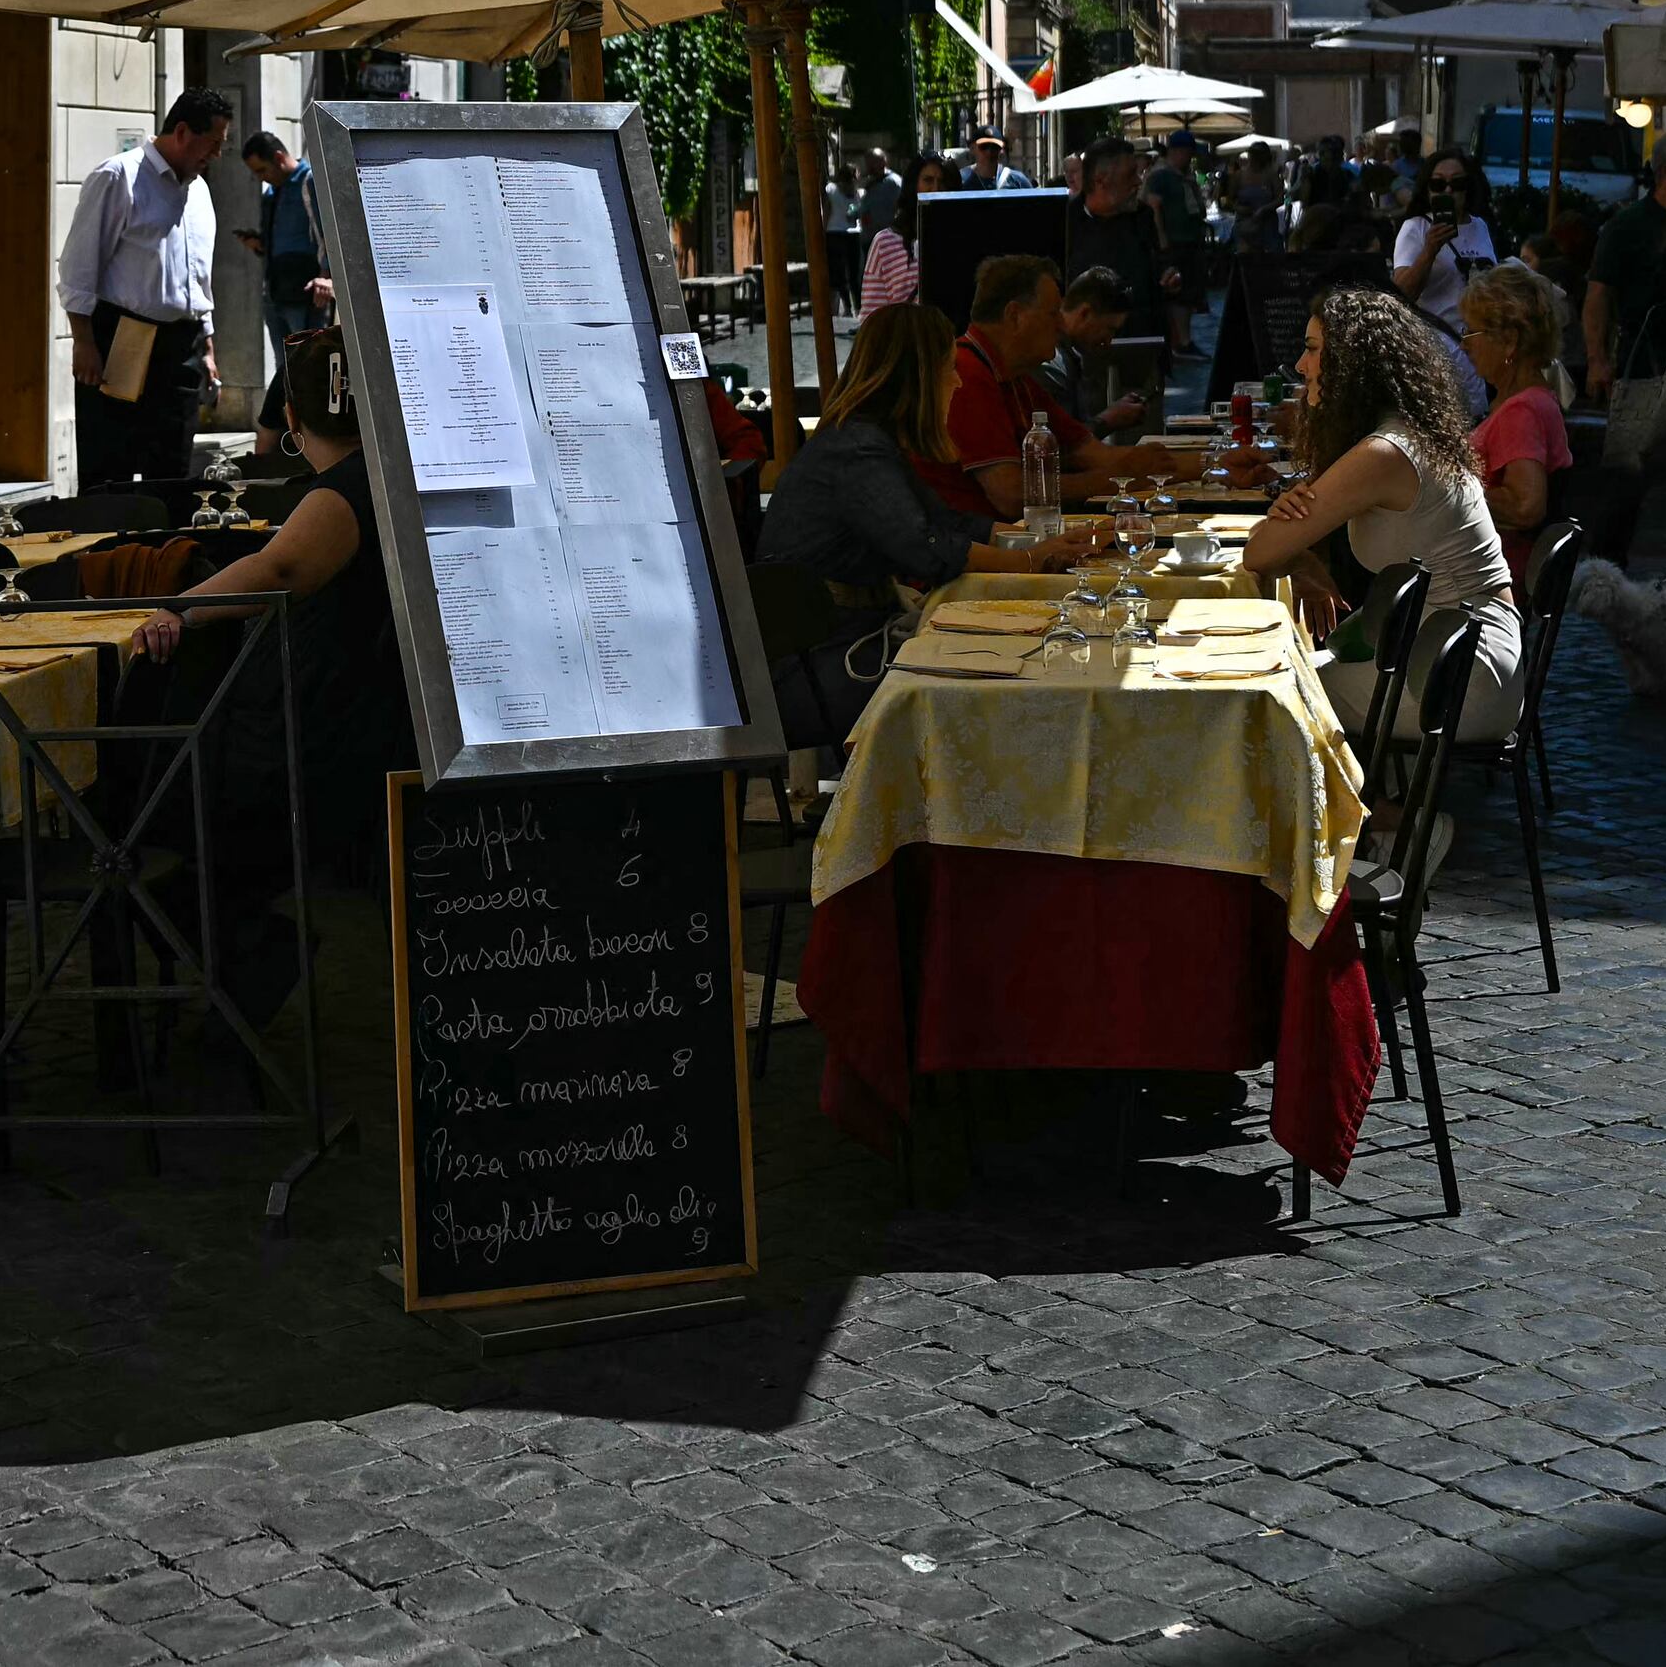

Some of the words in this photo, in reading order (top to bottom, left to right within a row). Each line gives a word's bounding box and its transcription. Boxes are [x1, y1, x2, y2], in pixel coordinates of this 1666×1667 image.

[615, 853, 643, 887] 6
[686, 911, 709, 943] 8
[417, 994, 514, 1061] Pasta
[694, 970, 714, 1005] 9
[418, 1059, 516, 1114] Pizza
[520, 1069, 660, 1104] marinara
[672, 1047, 693, 1077] 8
[424, 1127, 509, 1183] Pizza
[672, 1123, 688, 1150] 8
[583, 1192, 661, 1245] aglio
[669, 1184, 717, 1225] olio
[686, 1226, 710, 1255] 9
